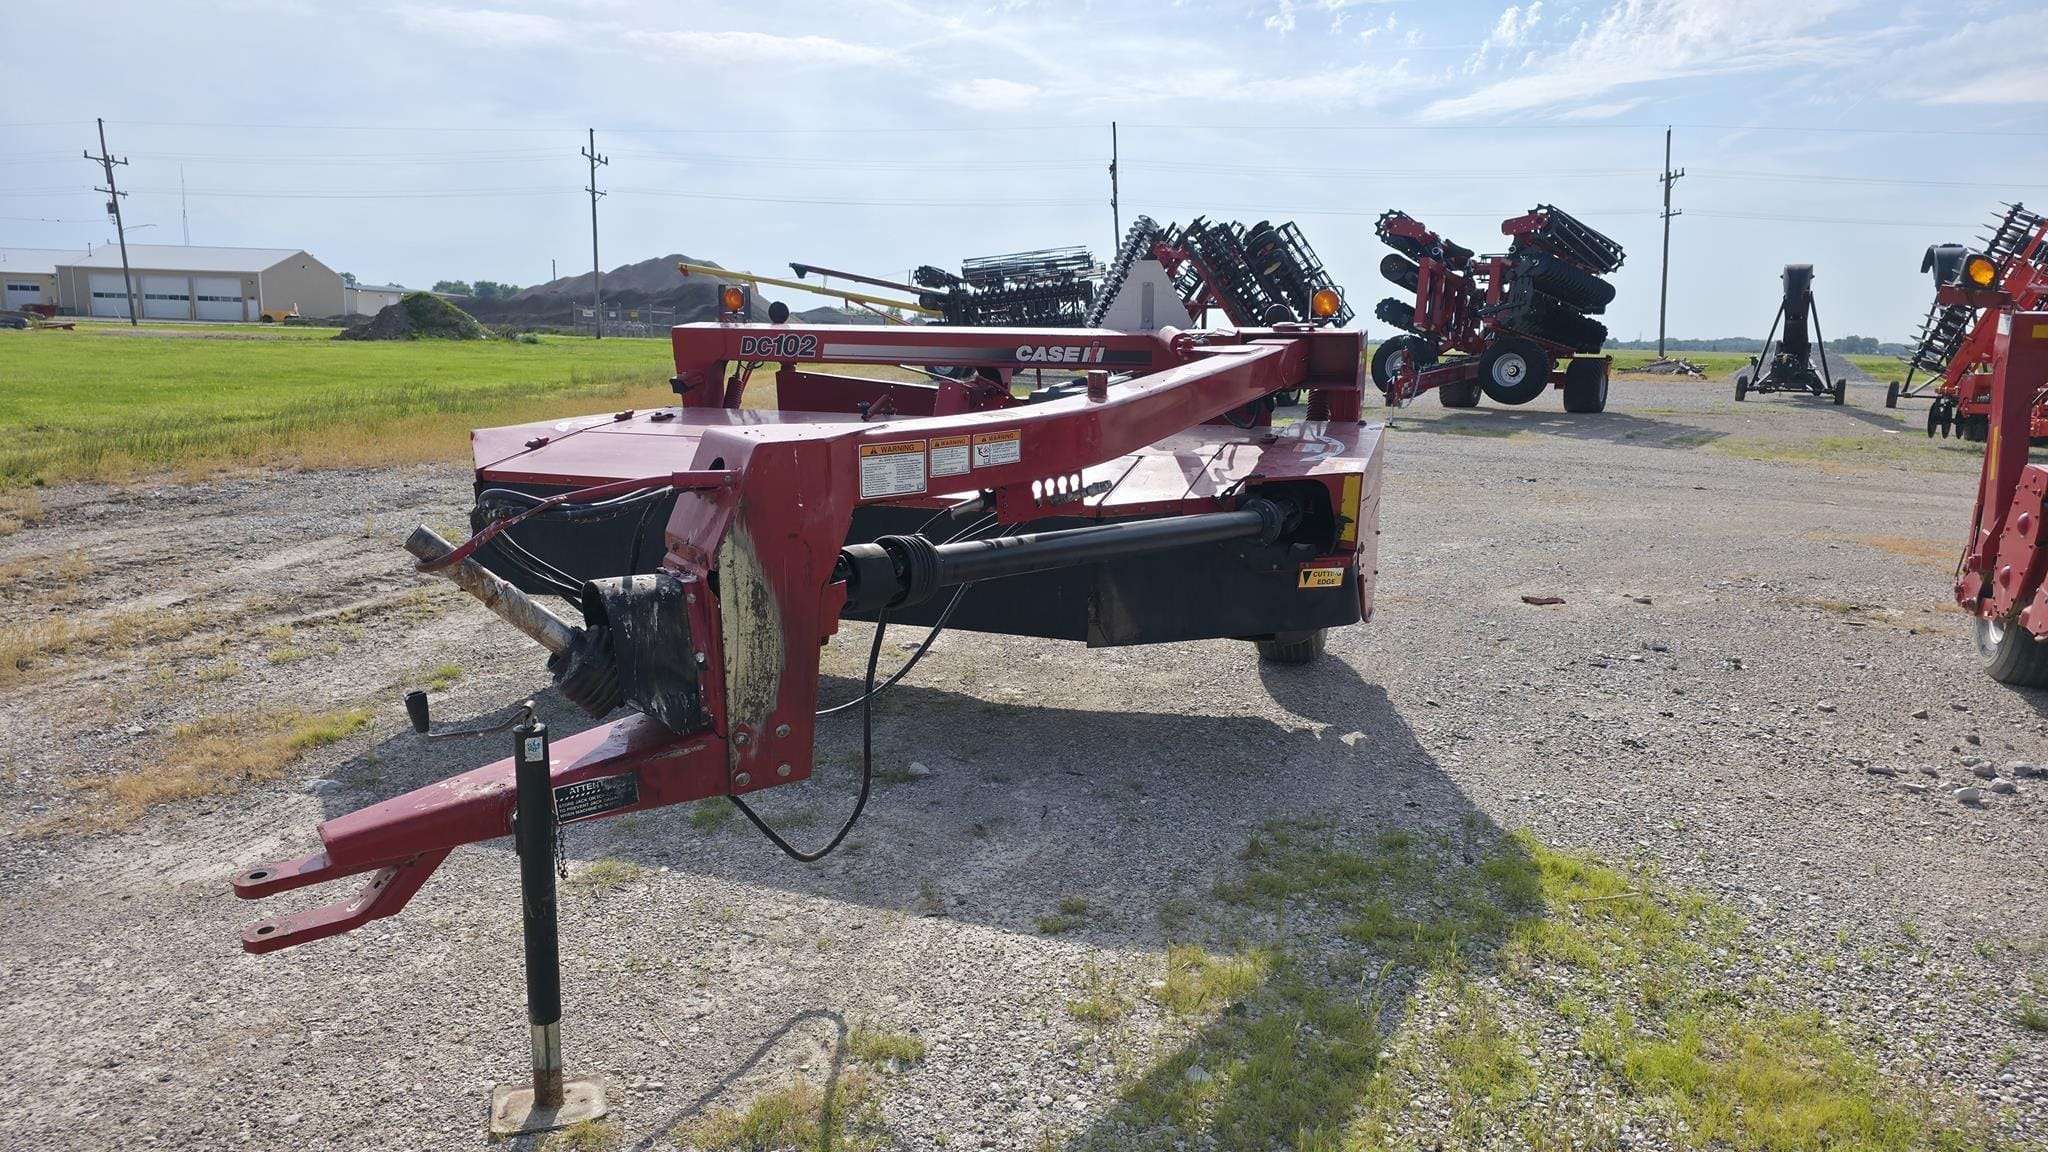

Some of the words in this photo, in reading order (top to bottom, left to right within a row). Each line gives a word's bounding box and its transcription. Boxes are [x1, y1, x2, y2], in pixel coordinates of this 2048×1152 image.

[740, 334, 817, 357] DC102
[1016, 345, 1080, 362] CASE
[941, 438, 966, 446] WARNING
[881, 444, 915, 453] WARNING
[567, 803, 589, 811] PREVENT
